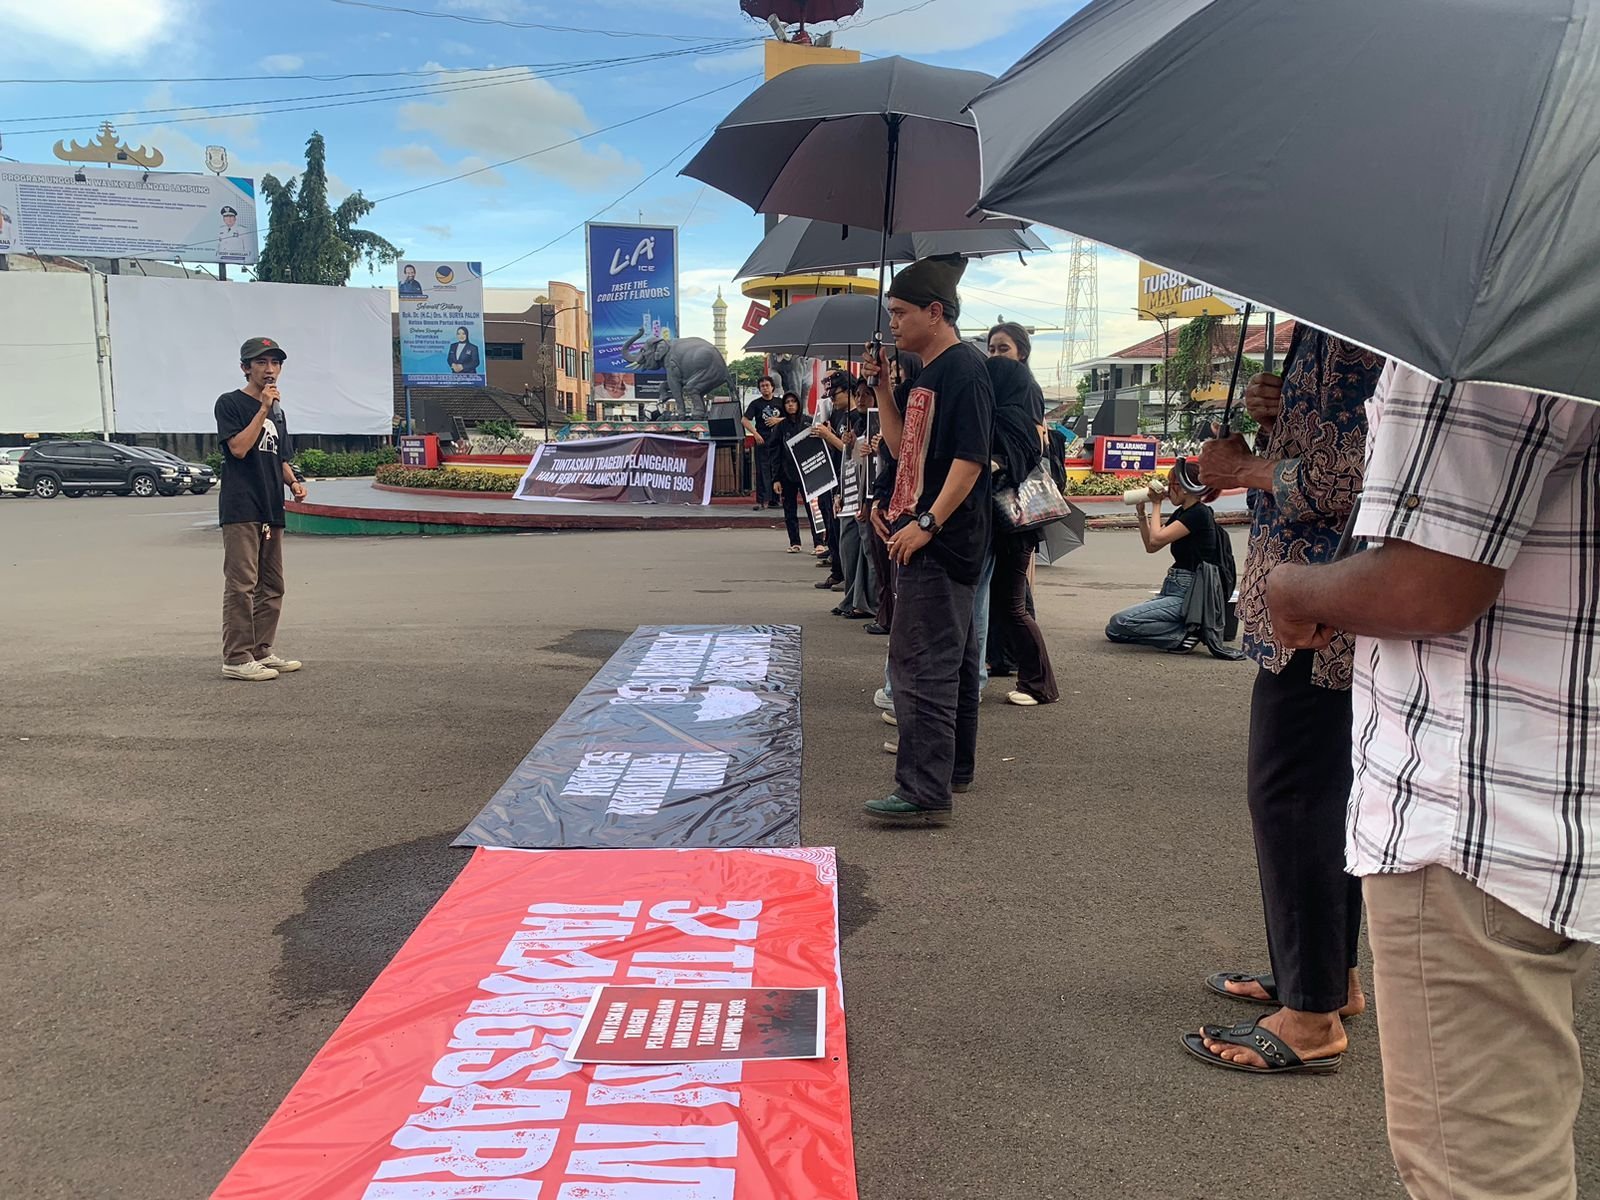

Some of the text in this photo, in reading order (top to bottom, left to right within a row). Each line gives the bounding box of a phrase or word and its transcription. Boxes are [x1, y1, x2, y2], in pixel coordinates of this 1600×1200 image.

[2, 173, 46, 182] PROGRAM
[47, 176, 93, 186] UNGGUN
[93, 179, 136, 189] WALIKOTA
[171, 184, 210, 194] LAMPUNG
[597, 286, 671, 302] COOLEST FLAVORS
[611, 279, 649, 292] TASTE THE
[535, 471, 694, 492] HAM BERAT TALANGSARI LAMPUNG 1989
[551, 454, 687, 473] TUNTASKAN TRAGEDI PELANGGARAN
[584, 944, 756, 1107] TAN
[595, 1001, 628, 1044] TUNTASKAN
[623, 1008, 650, 1038] TRAGEDI
[645, 999, 676, 1049] PELANGGARAN
[670, 999, 700, 1049] HAM BERAT DI
[696, 1003, 722, 1046] TALANGSARI
[721, 998, 746, 1051] LAMPUNG 1989.
[359, 899, 643, 1200] TALANGSARI
